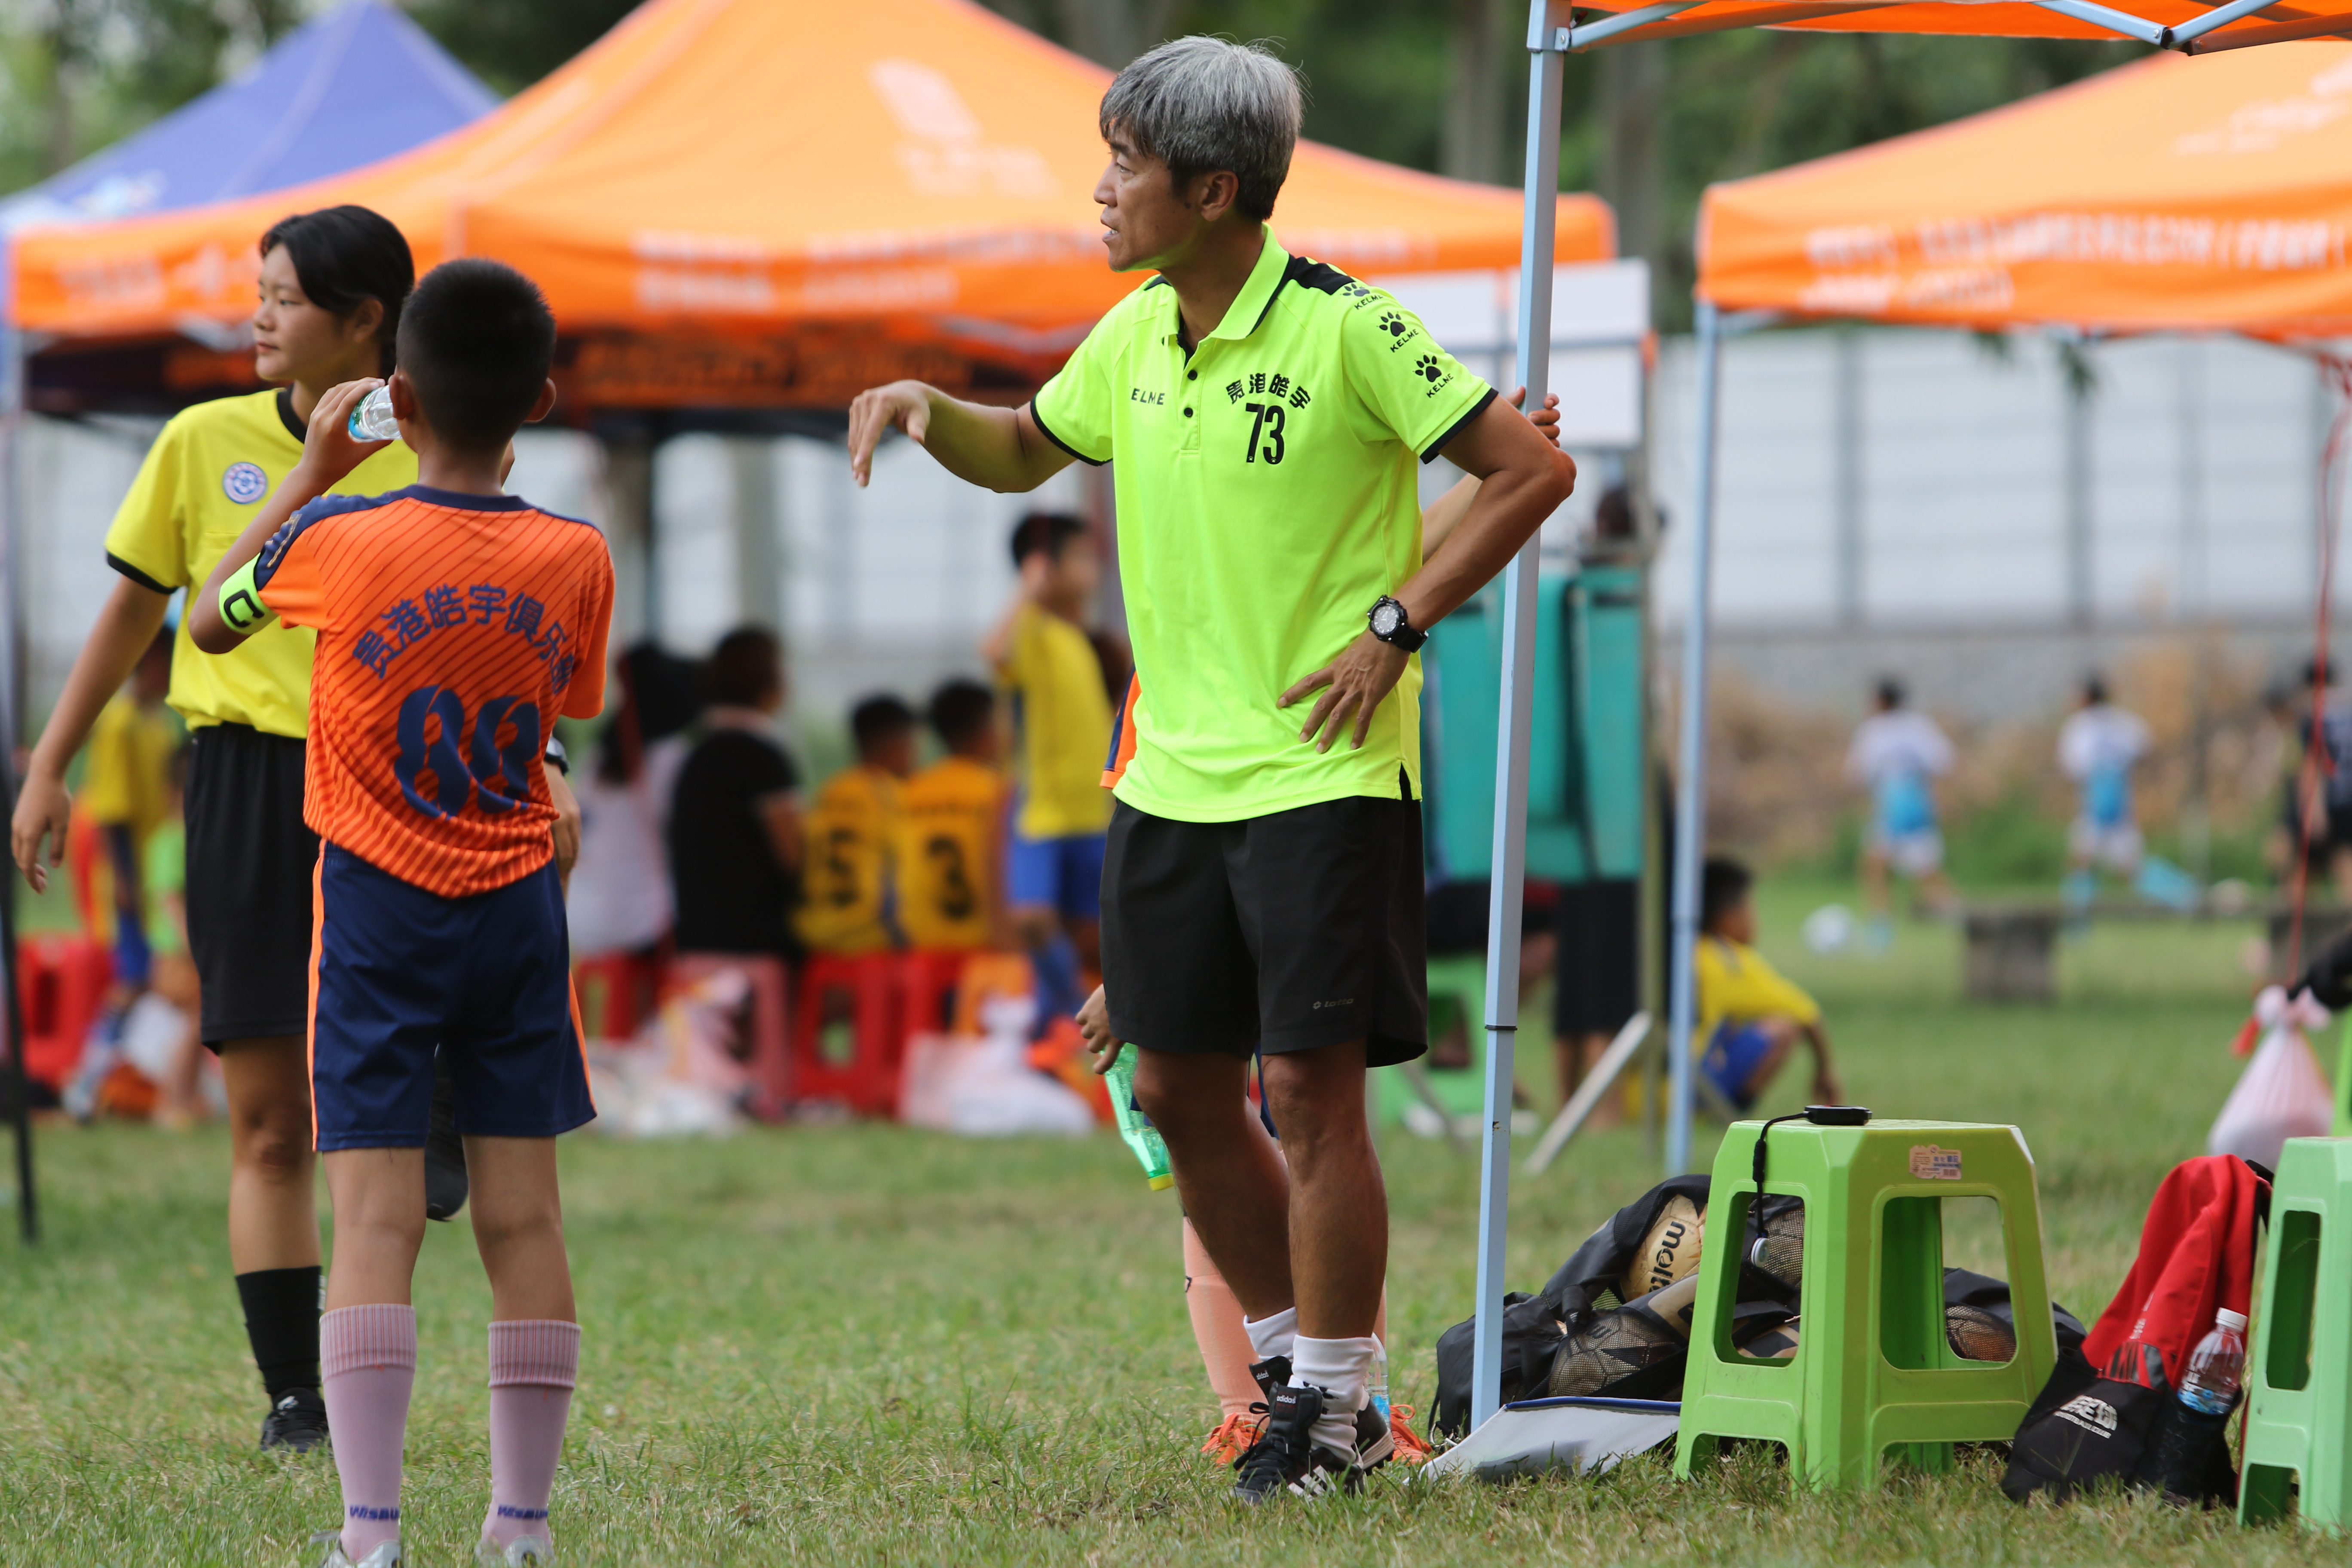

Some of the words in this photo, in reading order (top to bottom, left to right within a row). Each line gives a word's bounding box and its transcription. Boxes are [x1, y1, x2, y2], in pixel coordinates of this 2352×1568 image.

[1390, 329, 1419, 352] KELME
[1225, 373, 1311, 409] 贵港皓宇
[1246, 403, 1285, 465] 73
[224, 590, 265, 628] C
[394, 684, 540, 820] 88
[1324, 998, 1354, 1007] lotto
[1277, 1394, 1296, 1404] adidas
